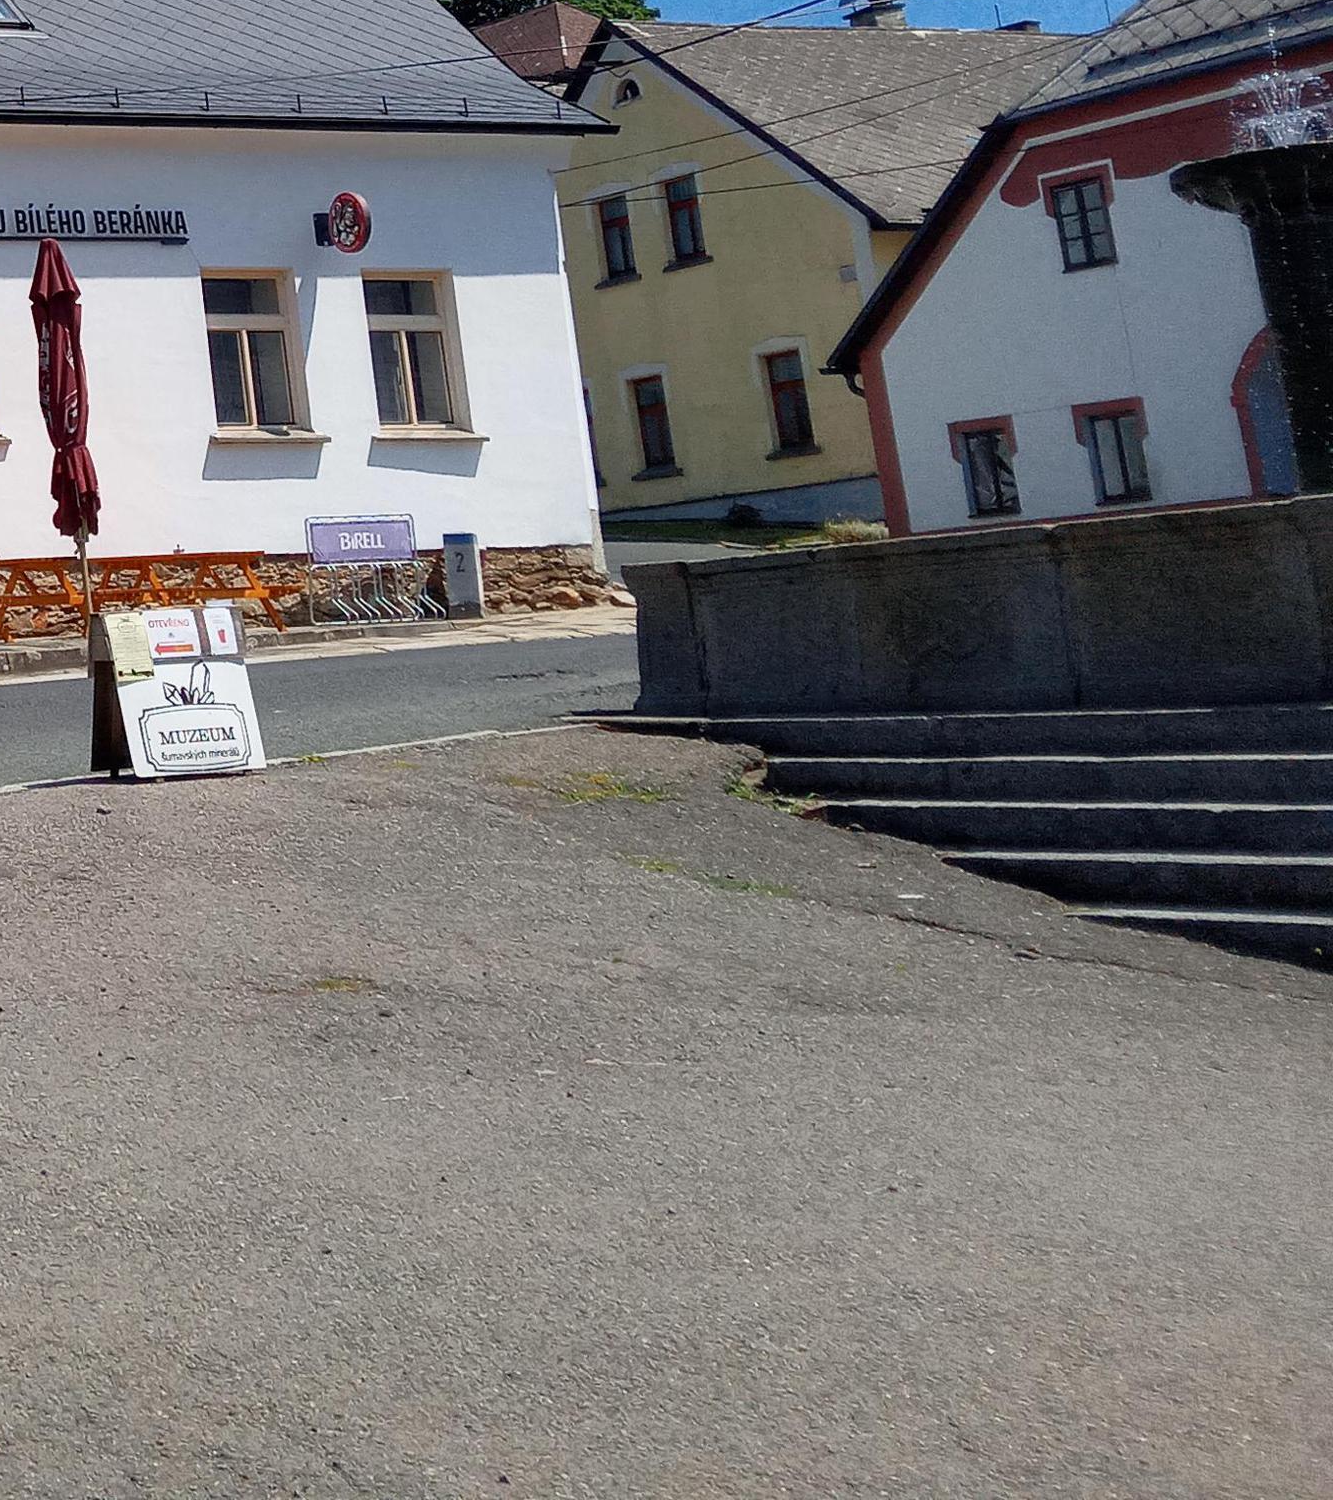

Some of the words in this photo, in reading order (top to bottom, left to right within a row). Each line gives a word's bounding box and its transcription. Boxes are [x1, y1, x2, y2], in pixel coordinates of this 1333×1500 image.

[14, 203, 86, 234] BÍLÉHO
[93, 204, 188, 235] BERÁNKA
[455, 553, 465, 572] 2
[159, 727, 236, 745] MUZEUM
